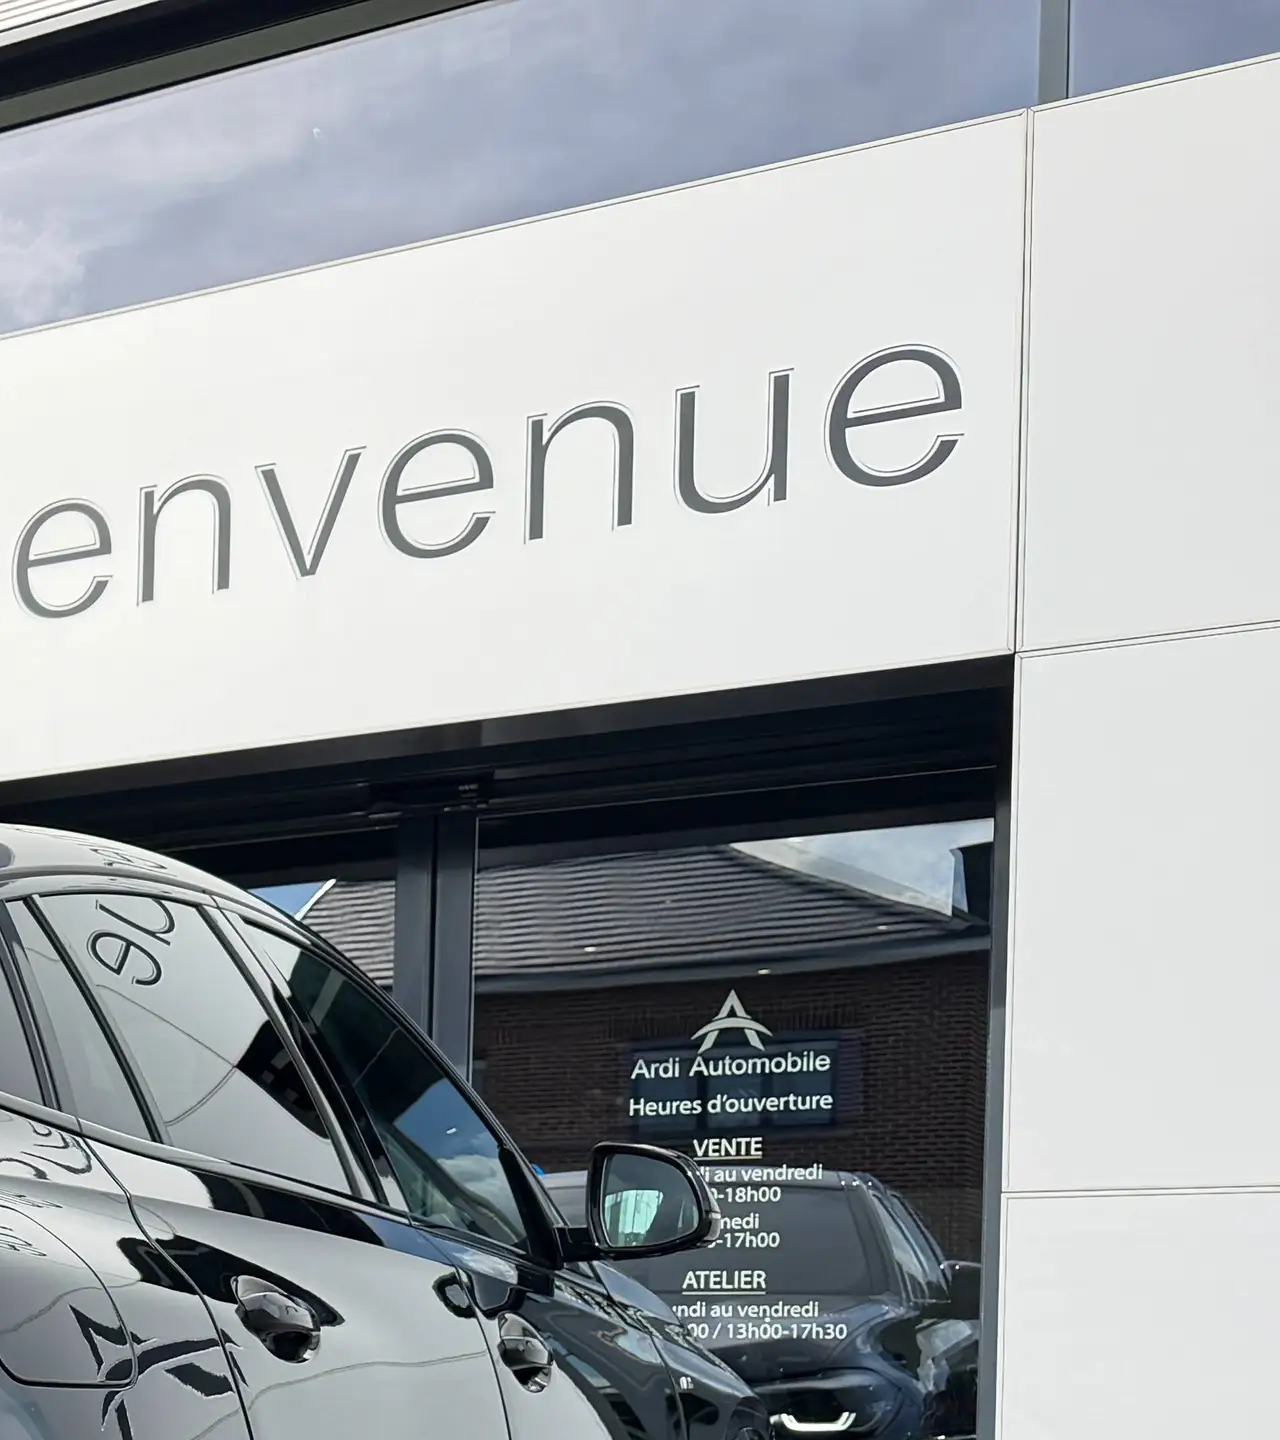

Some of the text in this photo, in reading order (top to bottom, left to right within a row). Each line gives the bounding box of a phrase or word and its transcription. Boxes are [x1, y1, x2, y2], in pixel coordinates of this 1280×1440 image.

[630, 1051, 831, 1079] Ardi Automobile
[629, 1093, 834, 1117] Heures d'ouverture
[693, 1137, 763, 1157] VENTE
[714, 1169, 737, 1182] au
[741, 1163, 823, 1181] vendredi
[708, 1231, 780, 1248] -17h00
[682, 1271, 767, 1289] ATELIER
[672, 1301, 819, 1318] ndi au vendredi
[728, 1323, 848, 1340] 13h00-17h30
